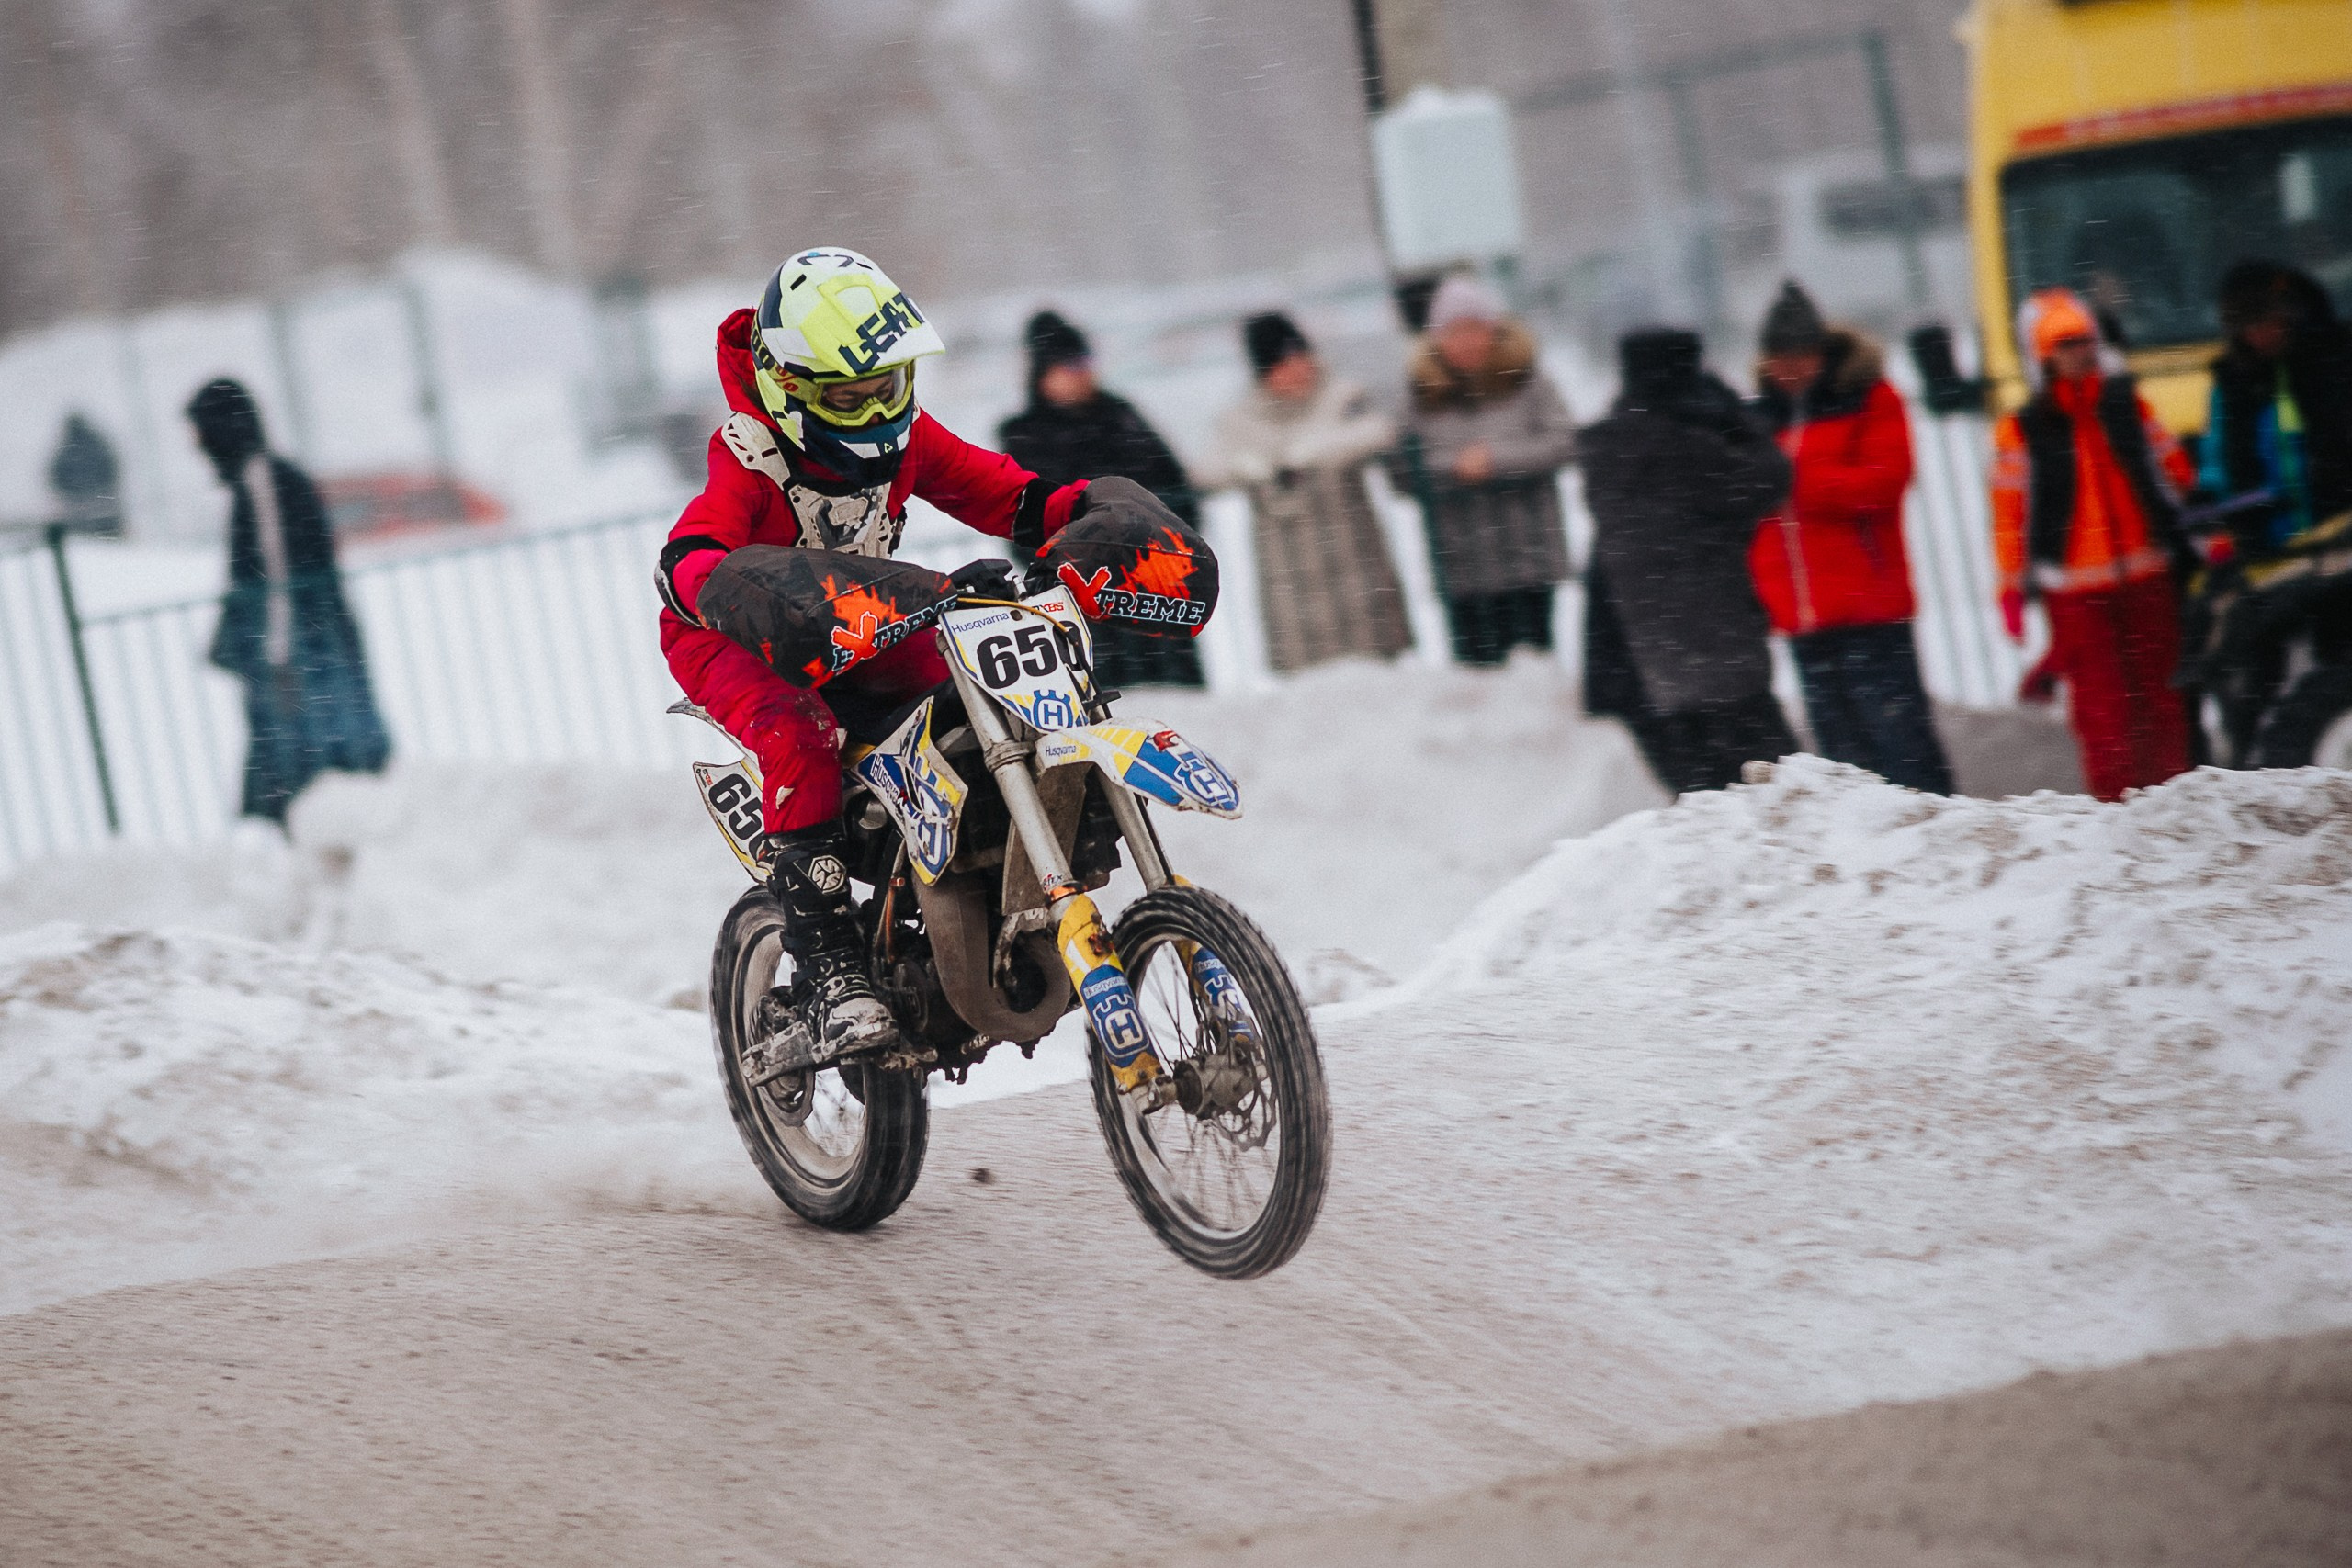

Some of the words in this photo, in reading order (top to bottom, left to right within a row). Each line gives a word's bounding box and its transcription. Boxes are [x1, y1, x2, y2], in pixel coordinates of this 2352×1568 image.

[951, 612, 1009, 634] Husqvarna
[1054, 562, 1206, 626] XTREME
[977, 620, 1085, 689] 650
